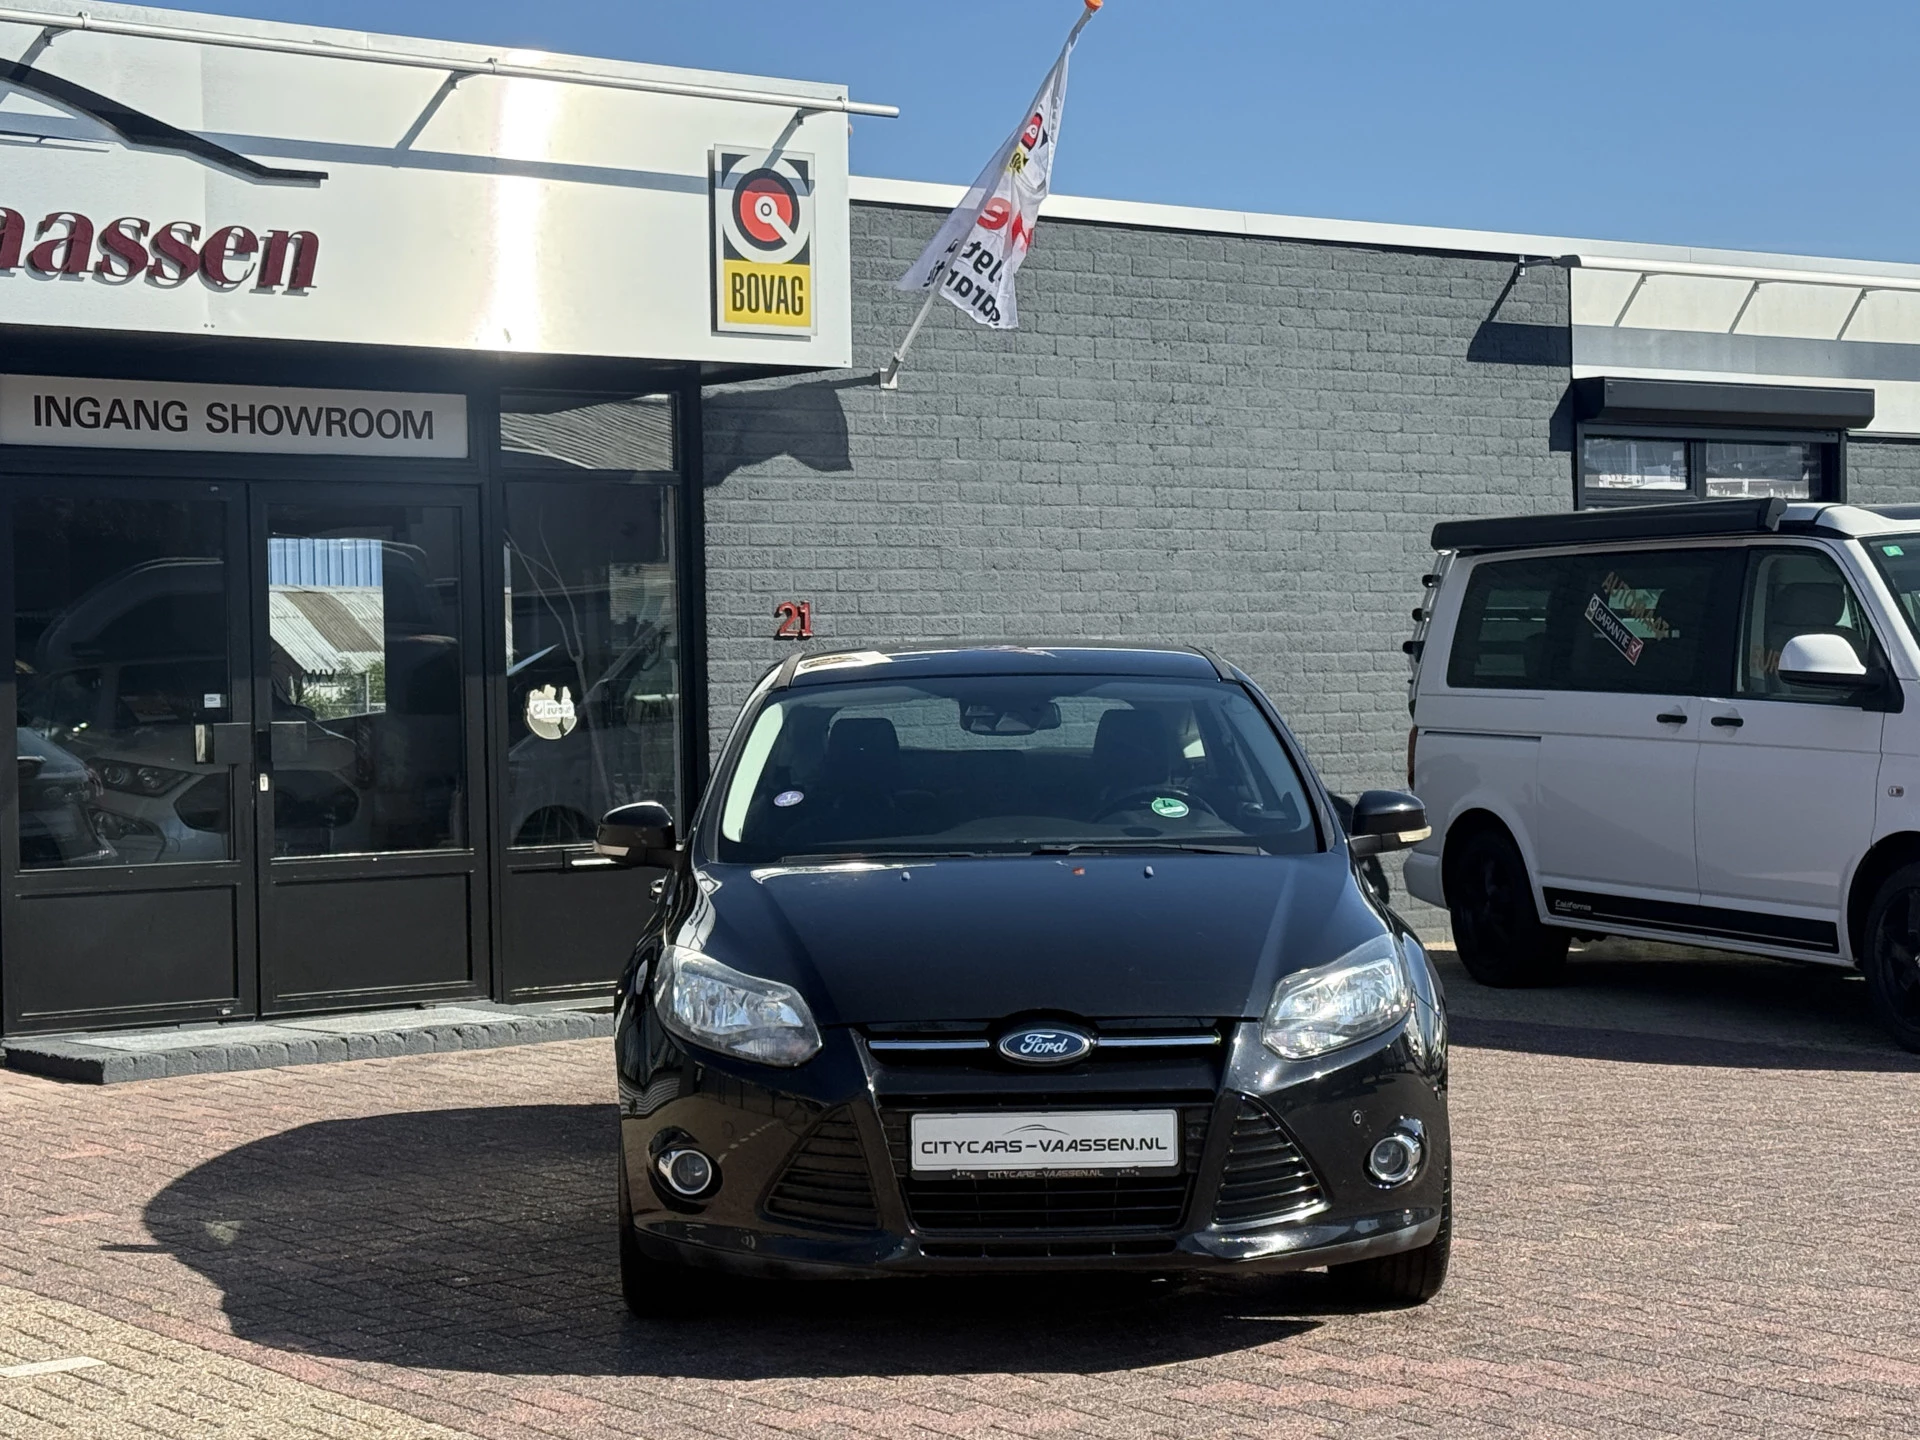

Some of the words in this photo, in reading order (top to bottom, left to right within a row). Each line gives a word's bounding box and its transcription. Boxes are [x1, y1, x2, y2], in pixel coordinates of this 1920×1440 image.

[731, 272, 804, 316] BOVAG
[33, 394, 188, 433] INGANG
[205, 401, 435, 441] SHOWROOM
[775, 600, 813, 639] 21
[1594, 607, 1632, 649] GARANTIE
[1555, 899, 1592, 911] California
[1020, 1033, 1068, 1054] Ford
[921, 1137, 1168, 1154] CITYCARS-VAASSEN.NL
[987, 1169, 1104, 1179] CITYCARS-VAASSEN.NL
